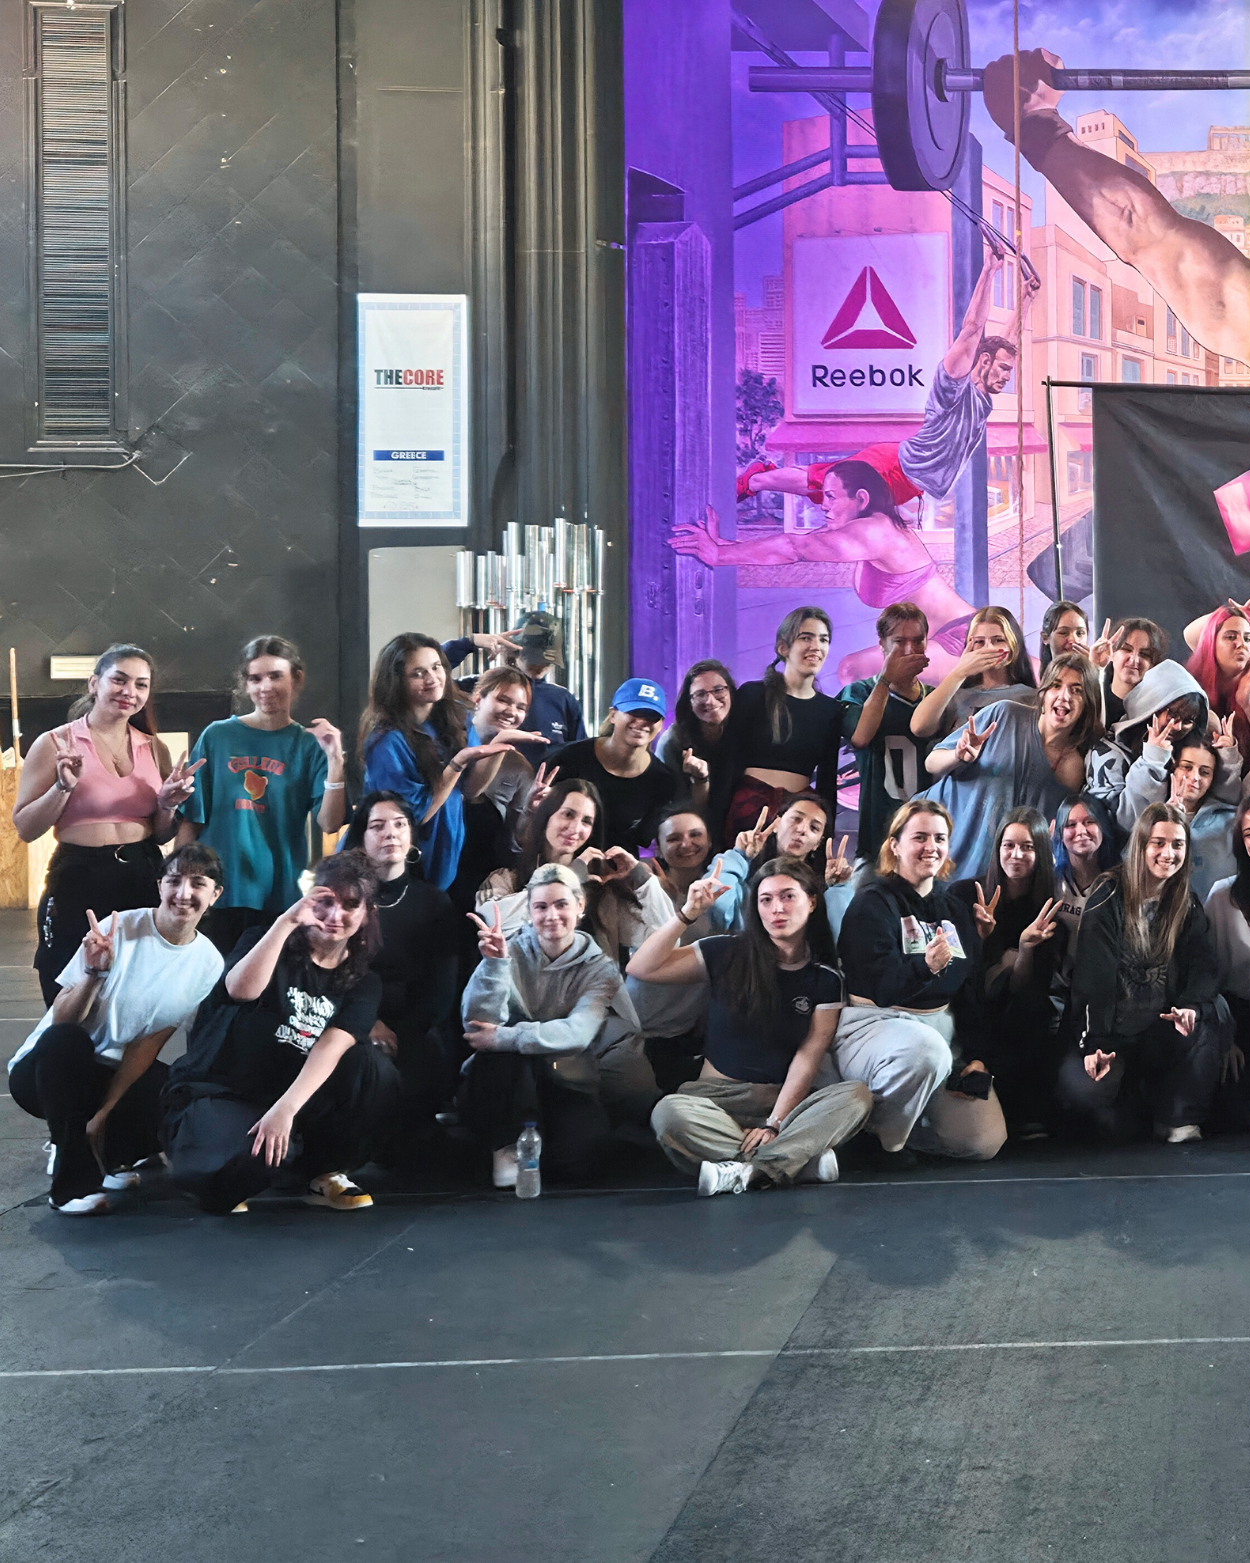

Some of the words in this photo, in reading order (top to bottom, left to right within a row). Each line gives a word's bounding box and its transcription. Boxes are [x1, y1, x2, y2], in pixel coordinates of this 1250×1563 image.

[374, 369, 444, 386] THECORE
[811, 364, 925, 388] Reebok
[391, 451, 428, 460] GREECE
